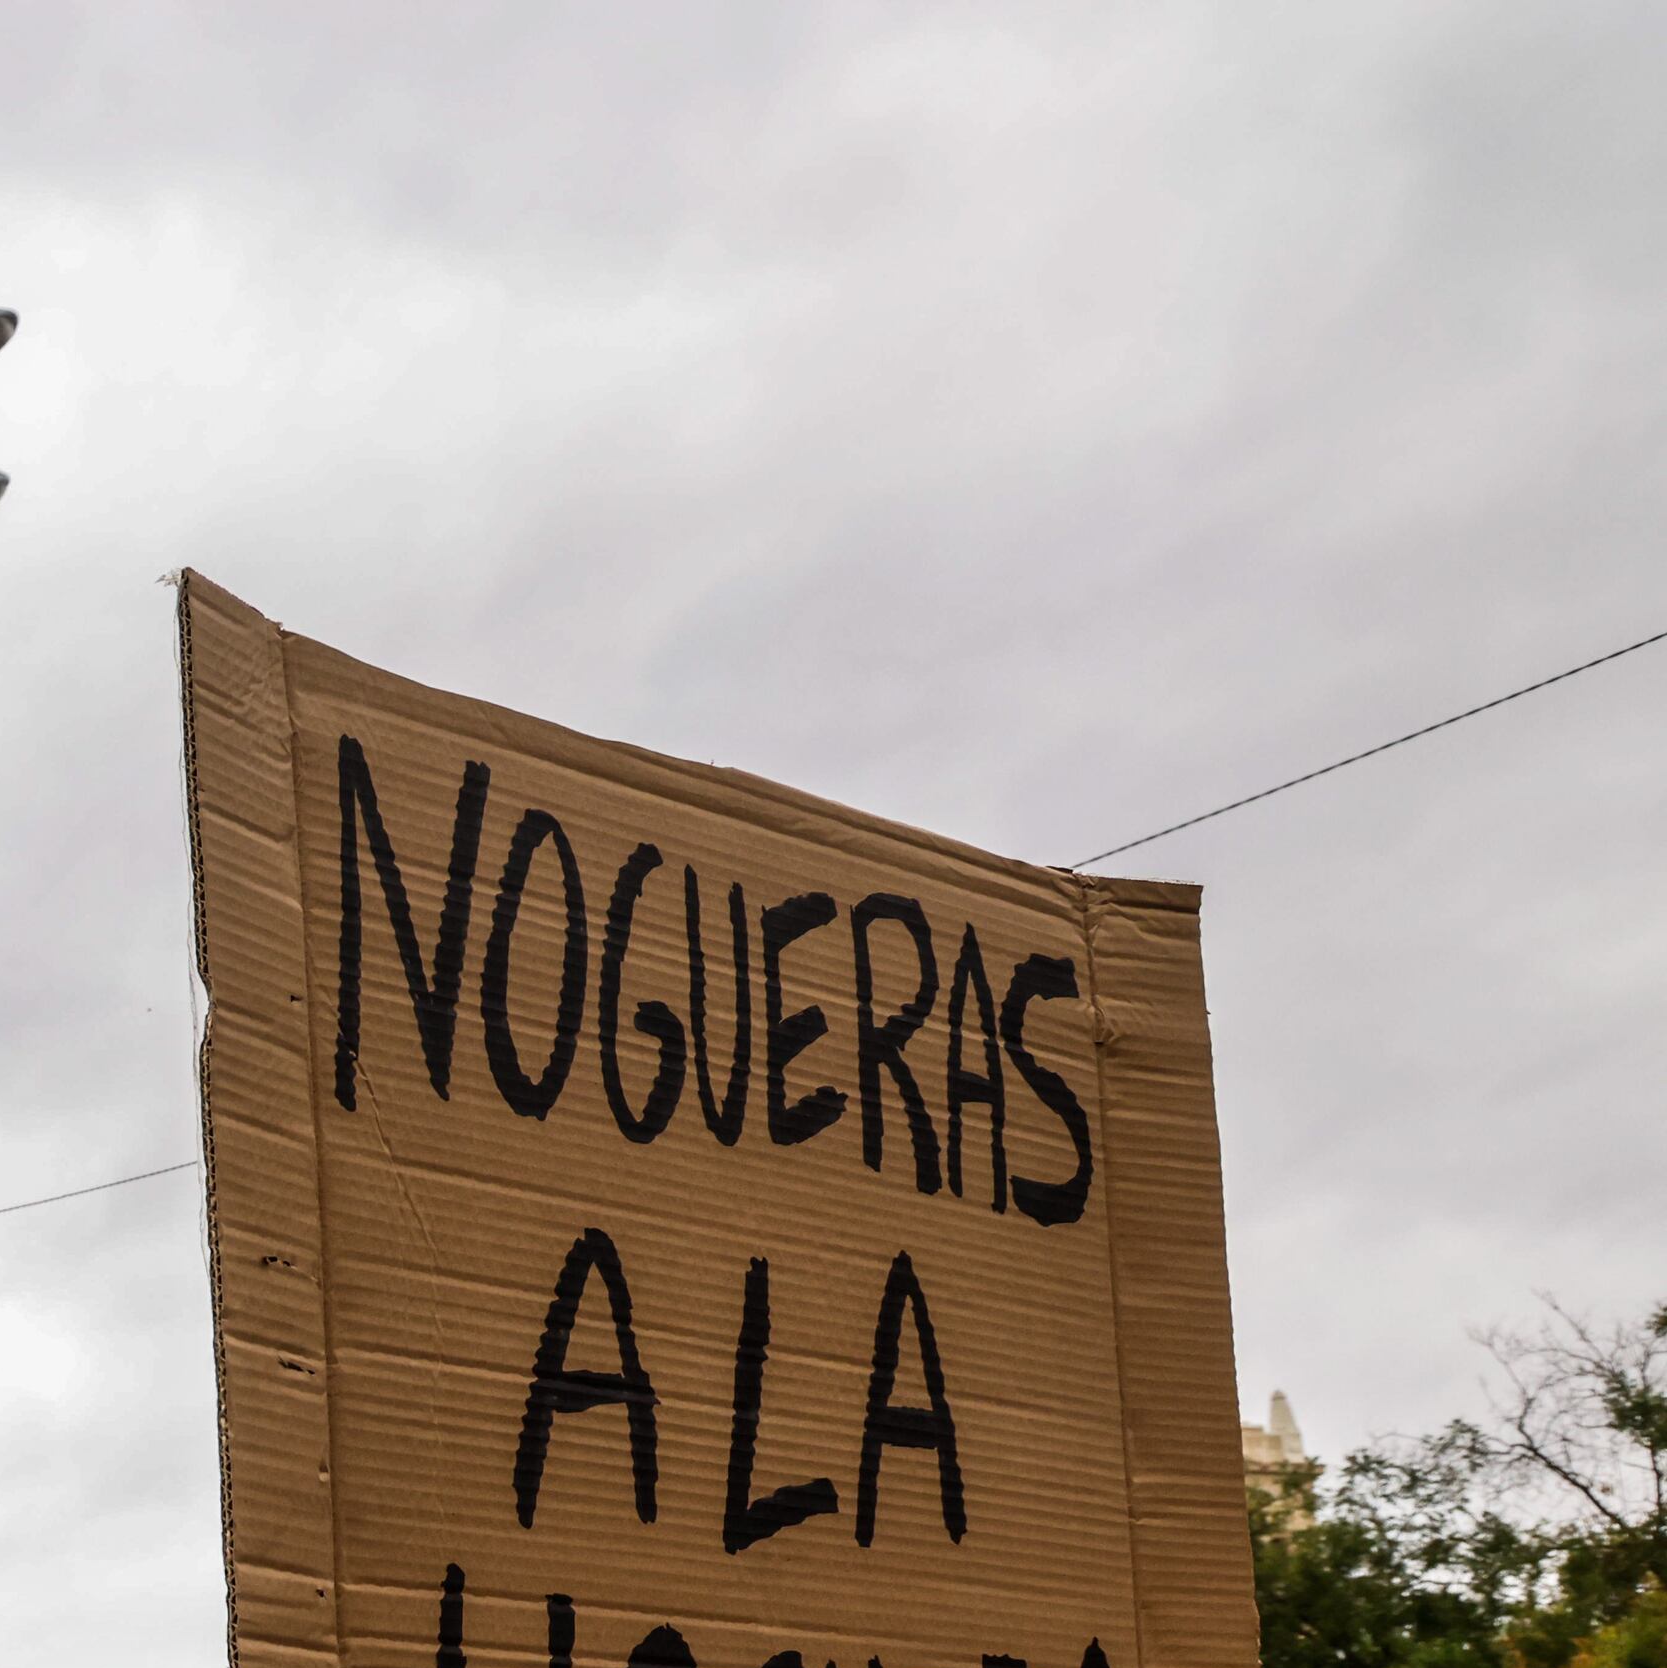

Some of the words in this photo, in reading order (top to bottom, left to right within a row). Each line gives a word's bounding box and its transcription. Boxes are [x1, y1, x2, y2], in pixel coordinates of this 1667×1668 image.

[334, 734, 1094, 1228] NOGUERAS
[512, 1227, 661, 1531] A
[722, 1250, 968, 1556] LA
